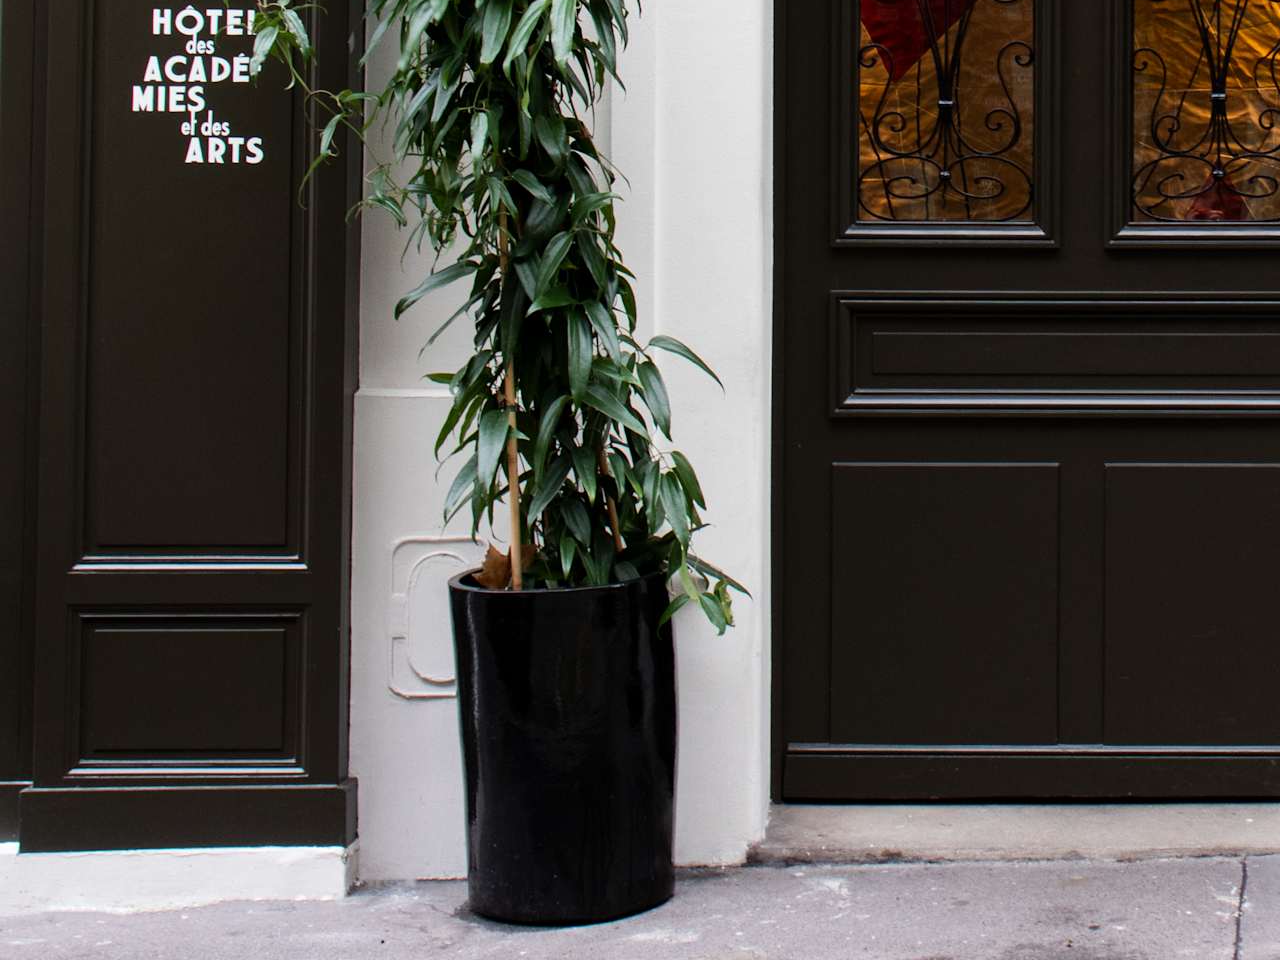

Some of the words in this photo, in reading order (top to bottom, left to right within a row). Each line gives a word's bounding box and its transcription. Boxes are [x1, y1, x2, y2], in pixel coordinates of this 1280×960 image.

[185, 32, 215, 55] des
[132, 85, 206, 113] MIES
[181, 110, 198, 135] et
[201, 110, 231, 136] des
[185, 137, 264, 164] ARTS
